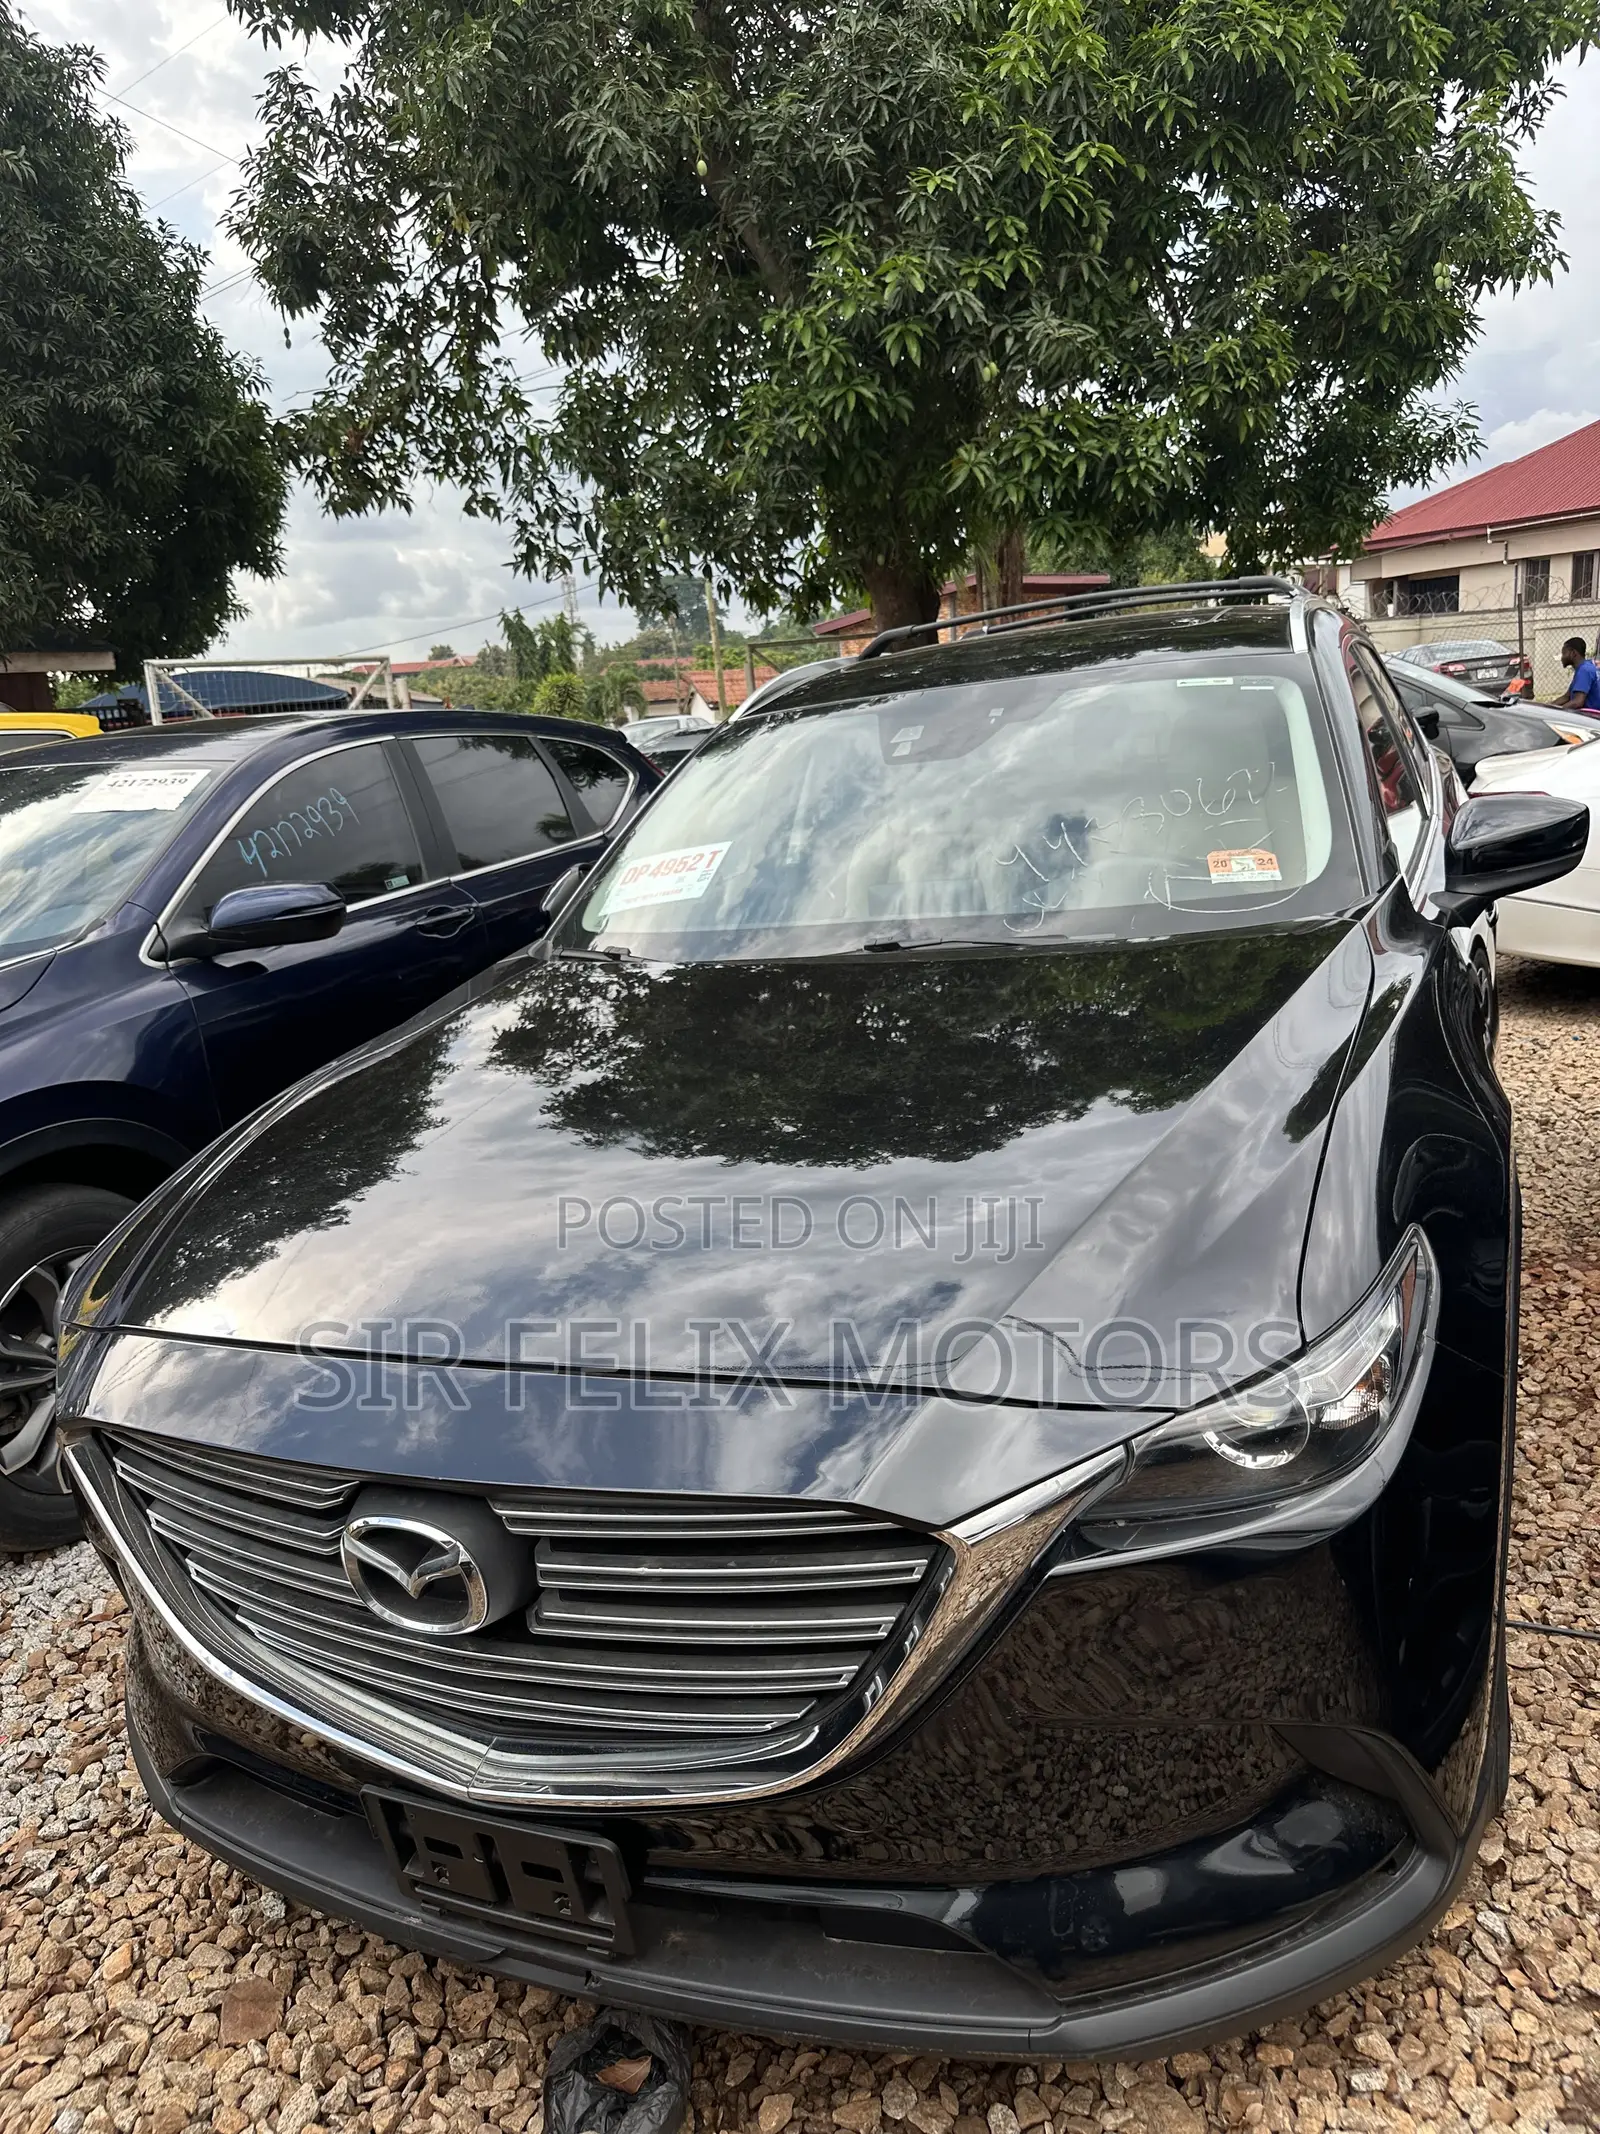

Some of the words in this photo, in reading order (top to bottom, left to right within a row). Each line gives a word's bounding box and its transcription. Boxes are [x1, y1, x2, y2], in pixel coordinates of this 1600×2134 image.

[238, 787, 361, 878] 42172939
[1213, 860, 1228, 868] 20
[1257, 858, 1274, 866] 24
